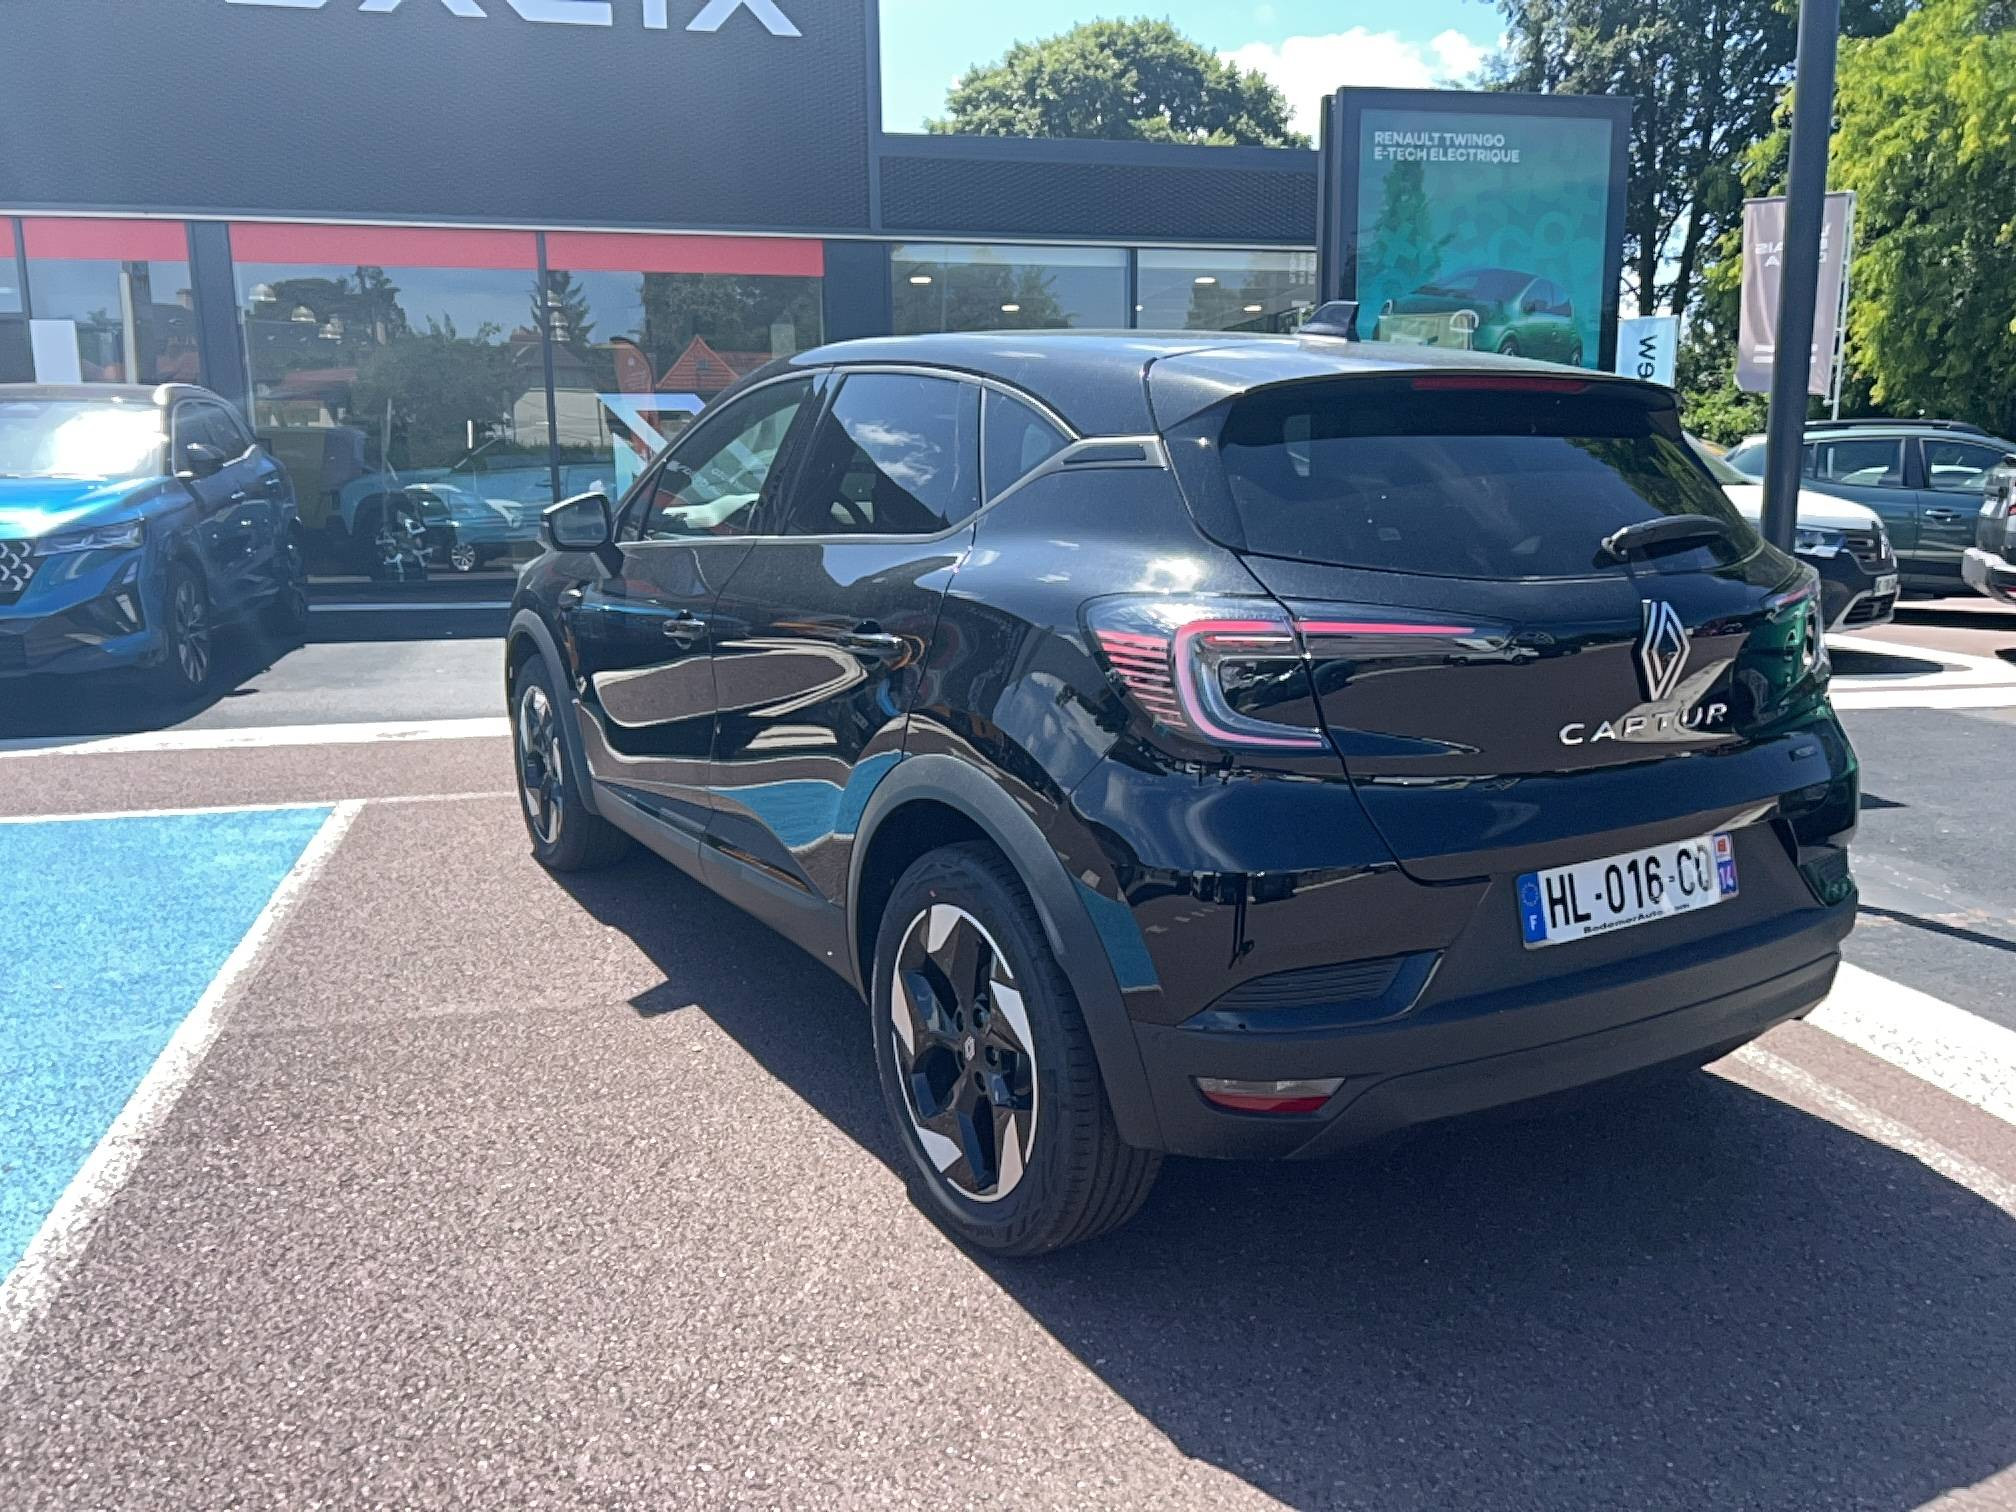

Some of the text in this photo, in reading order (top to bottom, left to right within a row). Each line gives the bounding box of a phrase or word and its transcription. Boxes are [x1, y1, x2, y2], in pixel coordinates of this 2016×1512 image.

[1374, 131, 1505, 147] RENAULT TWINGO
[1374, 146, 1521, 164] E-TECH ELECTRIQUE
[1559, 702, 1728, 746] CAPTUR
[1529, 914, 1538, 931] F
